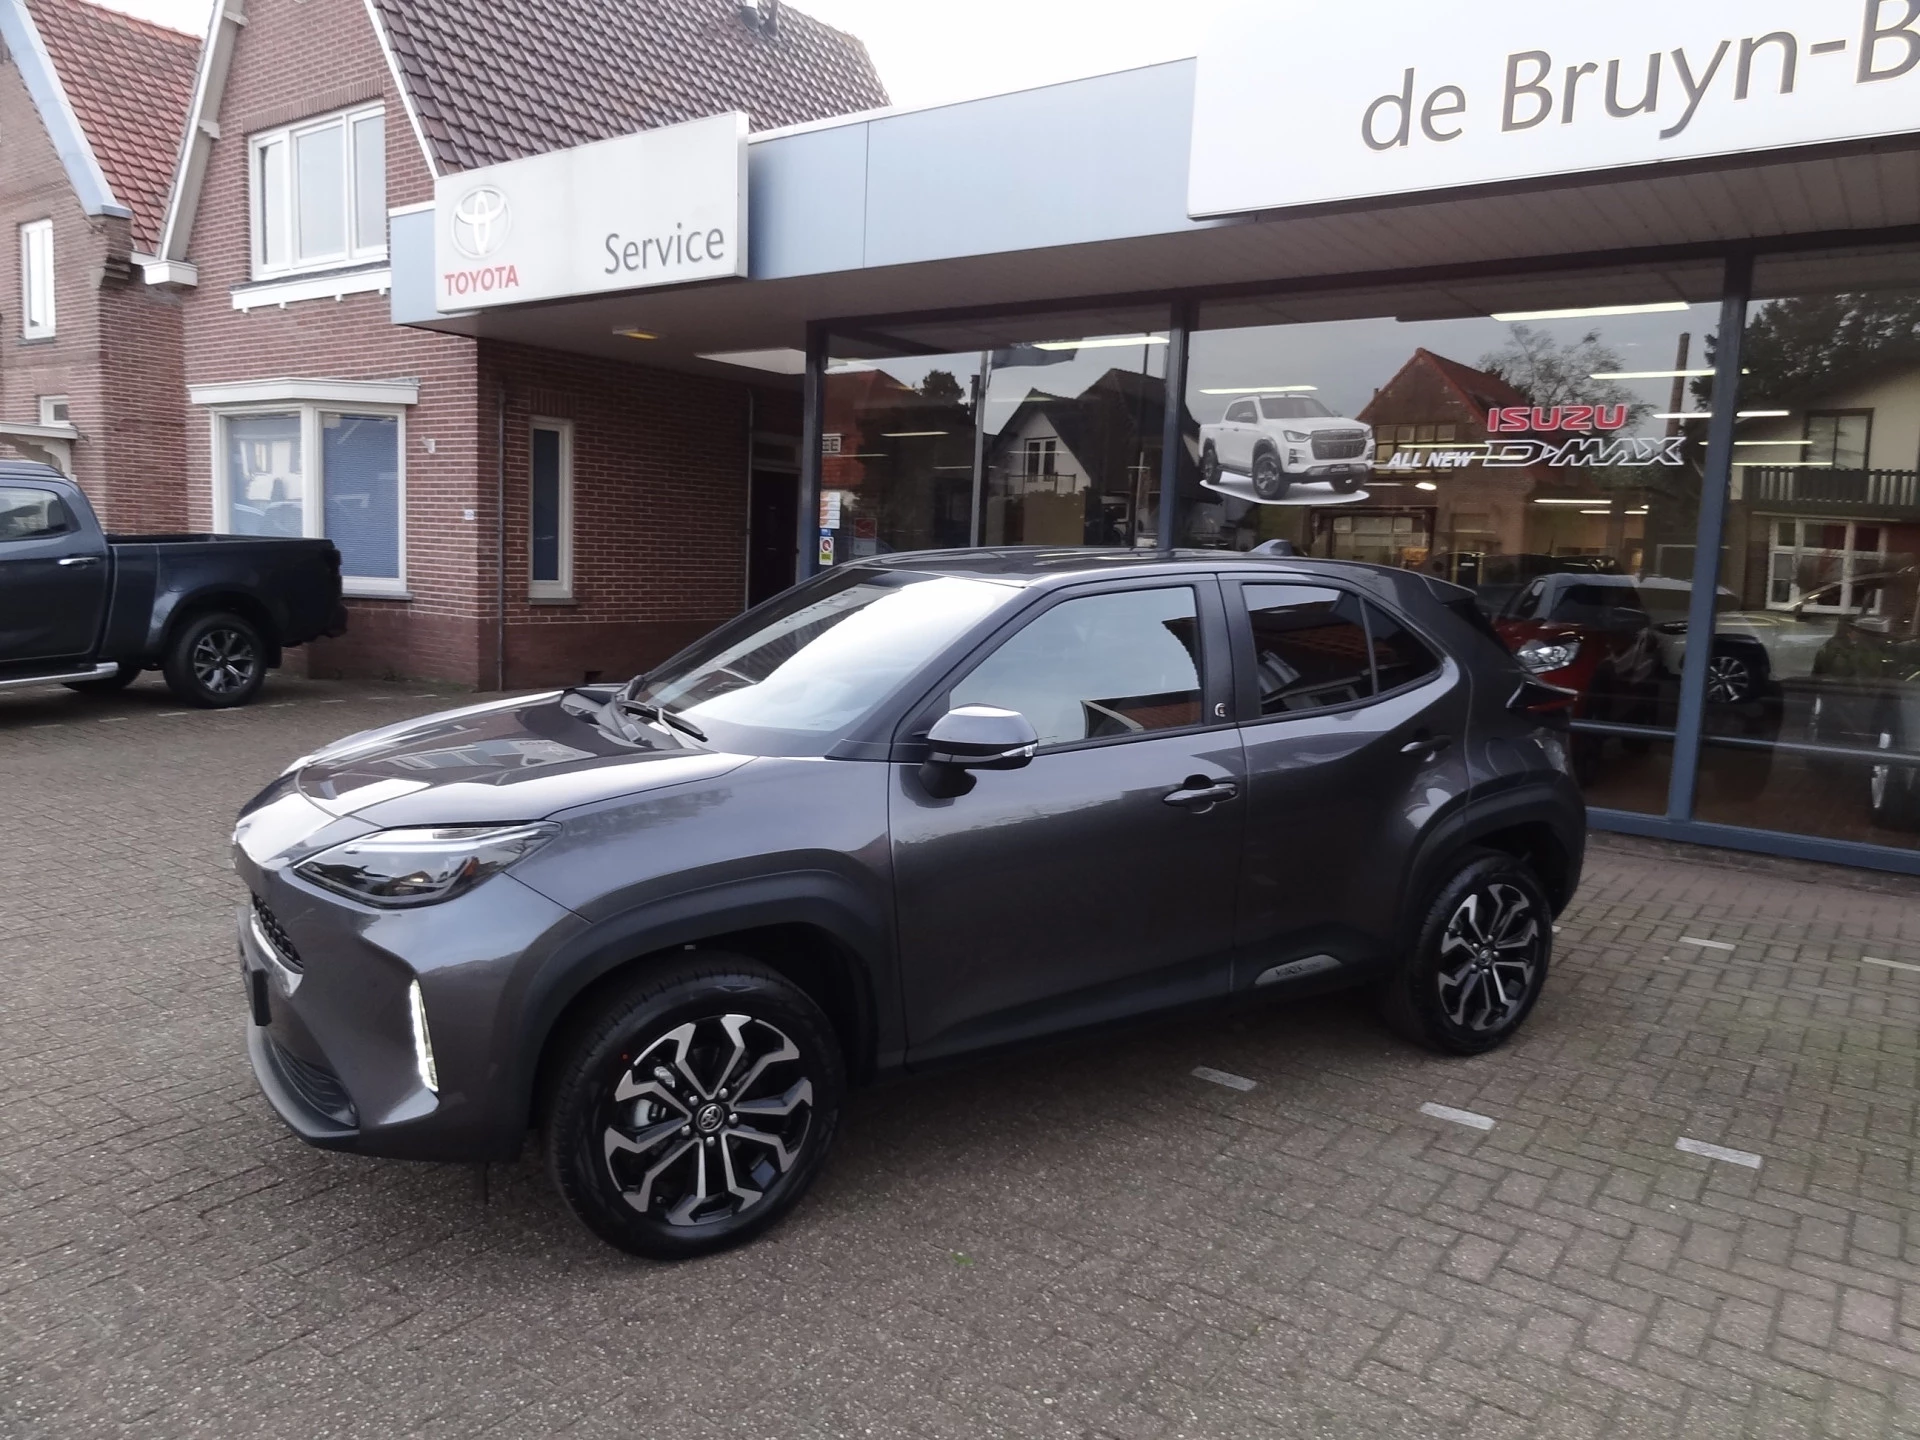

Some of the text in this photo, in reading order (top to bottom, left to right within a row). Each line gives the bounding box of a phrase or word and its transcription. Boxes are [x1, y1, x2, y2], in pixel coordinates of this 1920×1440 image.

[1361, 0, 1920, 151] de Bruyn-B
[604, 222, 725, 275] Service
[444, 264, 519, 296] TOYOTA
[1487, 404, 1628, 432] ISUZU
[1386, 452, 1422, 468] ALL
[1426, 452, 1475, 467] NEW
